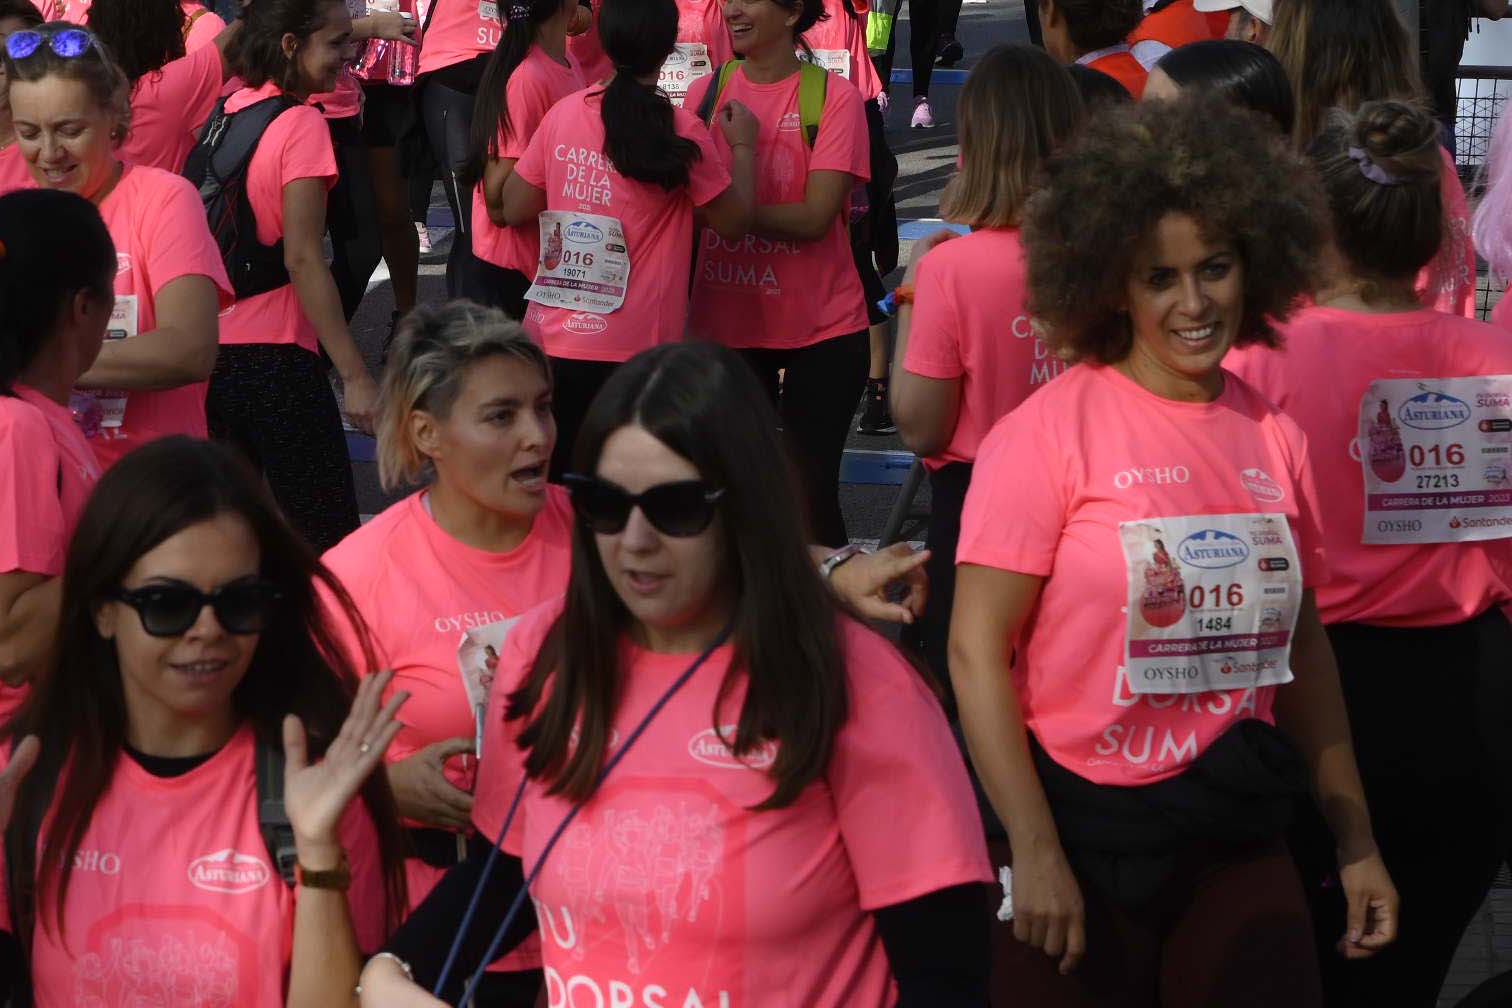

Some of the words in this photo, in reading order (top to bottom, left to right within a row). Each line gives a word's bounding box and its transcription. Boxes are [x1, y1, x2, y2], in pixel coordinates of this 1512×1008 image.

[567, 164, 586, 183] DE
[590, 172, 611, 190] LA
[562, 181, 612, 207] MUJER
[562, 250, 594, 266] 016
[563, 267, 587, 279] 19071
[703, 259, 778, 287] SUMA
[581, 295, 615, 308] Santander
[1404, 407, 1465, 422] ASTURIANA
[1409, 443, 1466, 468] 016
[1416, 473, 1460, 489] 27213
[1421, 497, 1435, 506] DE
[1436, 497, 1448, 505] LA
[1450, 495, 1485, 504] MUJER
[1377, 518, 1423, 533] OYSHO
[1185, 544, 1248, 561] ASTURIANA
[1189, 582, 1245, 609] 016
[434, 611, 506, 634] OYSHO
[1196, 616, 1233, 633] 1484
[1144, 665, 1199, 682] OYSHO
[1094, 723, 1199, 766] SUM
[192, 862, 264, 884] ASTURIANA
